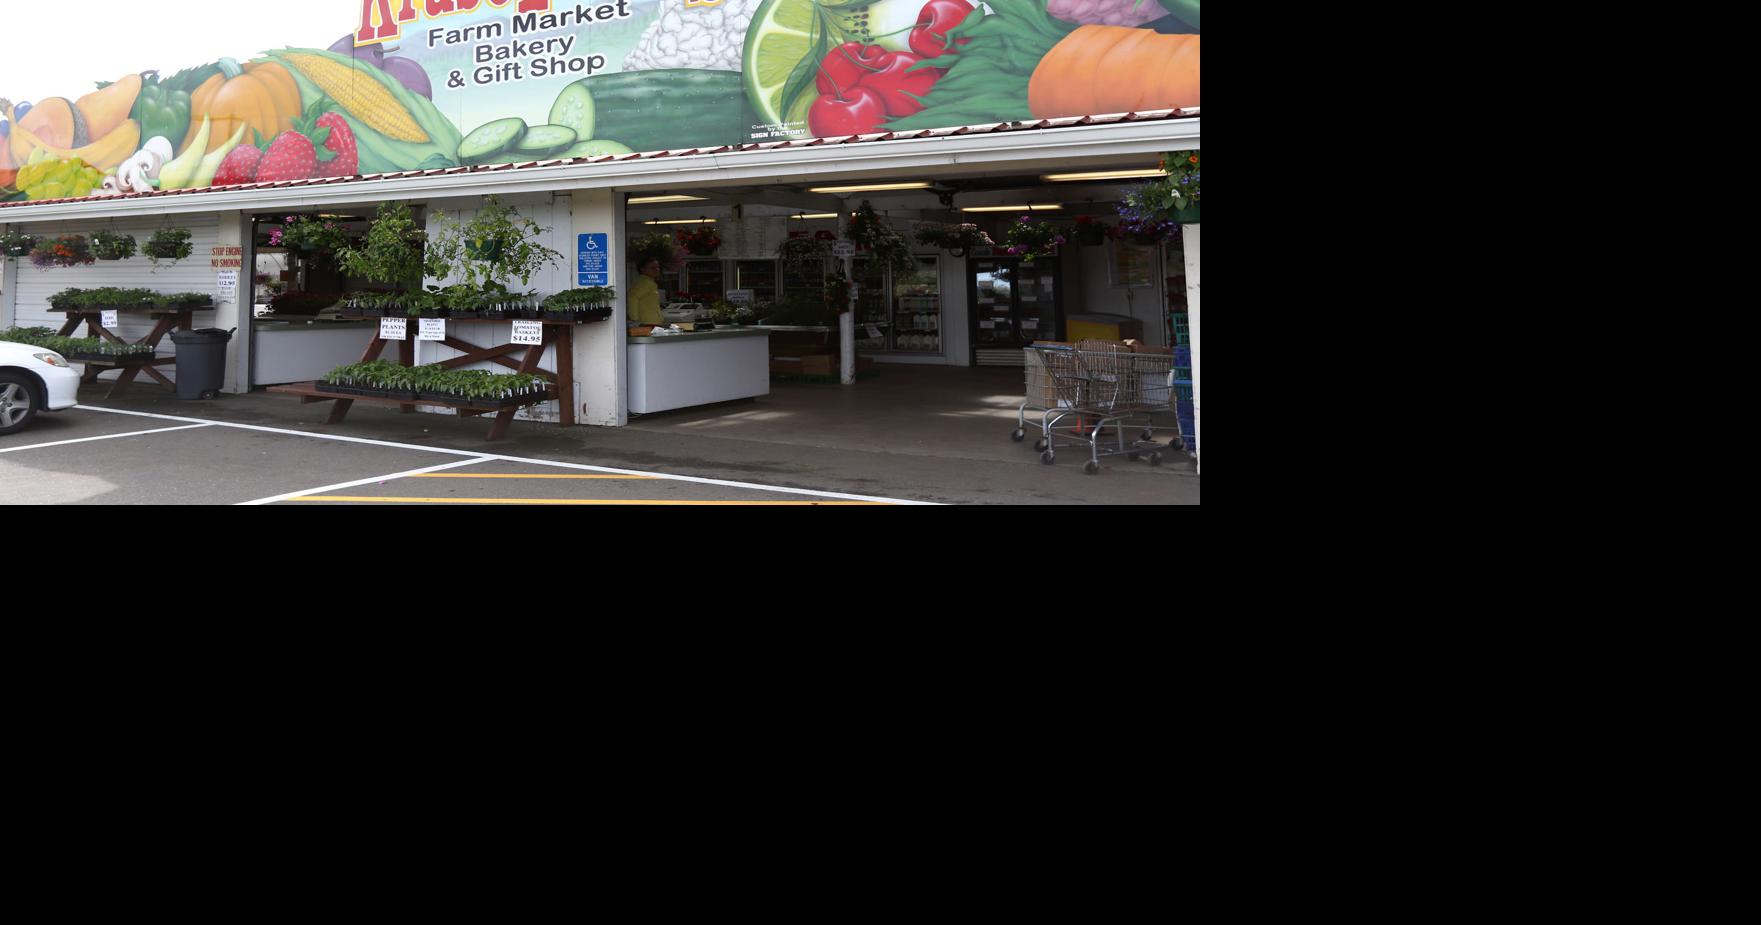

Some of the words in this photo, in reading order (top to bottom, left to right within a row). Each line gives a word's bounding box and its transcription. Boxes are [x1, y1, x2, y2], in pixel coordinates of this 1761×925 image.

[428, 21, 502, 48] Farm
[512, 0, 630, 35] Market
[475, 35, 575, 63] Bakery
[447, 71, 465, 89] &
[473, 61, 522, 85] Gift
[530, 52, 606, 78] Shop
[770, 128, 806, 137] FACTORY
[212, 247, 225, 256] STOP
[211, 258, 219, 268] NO
